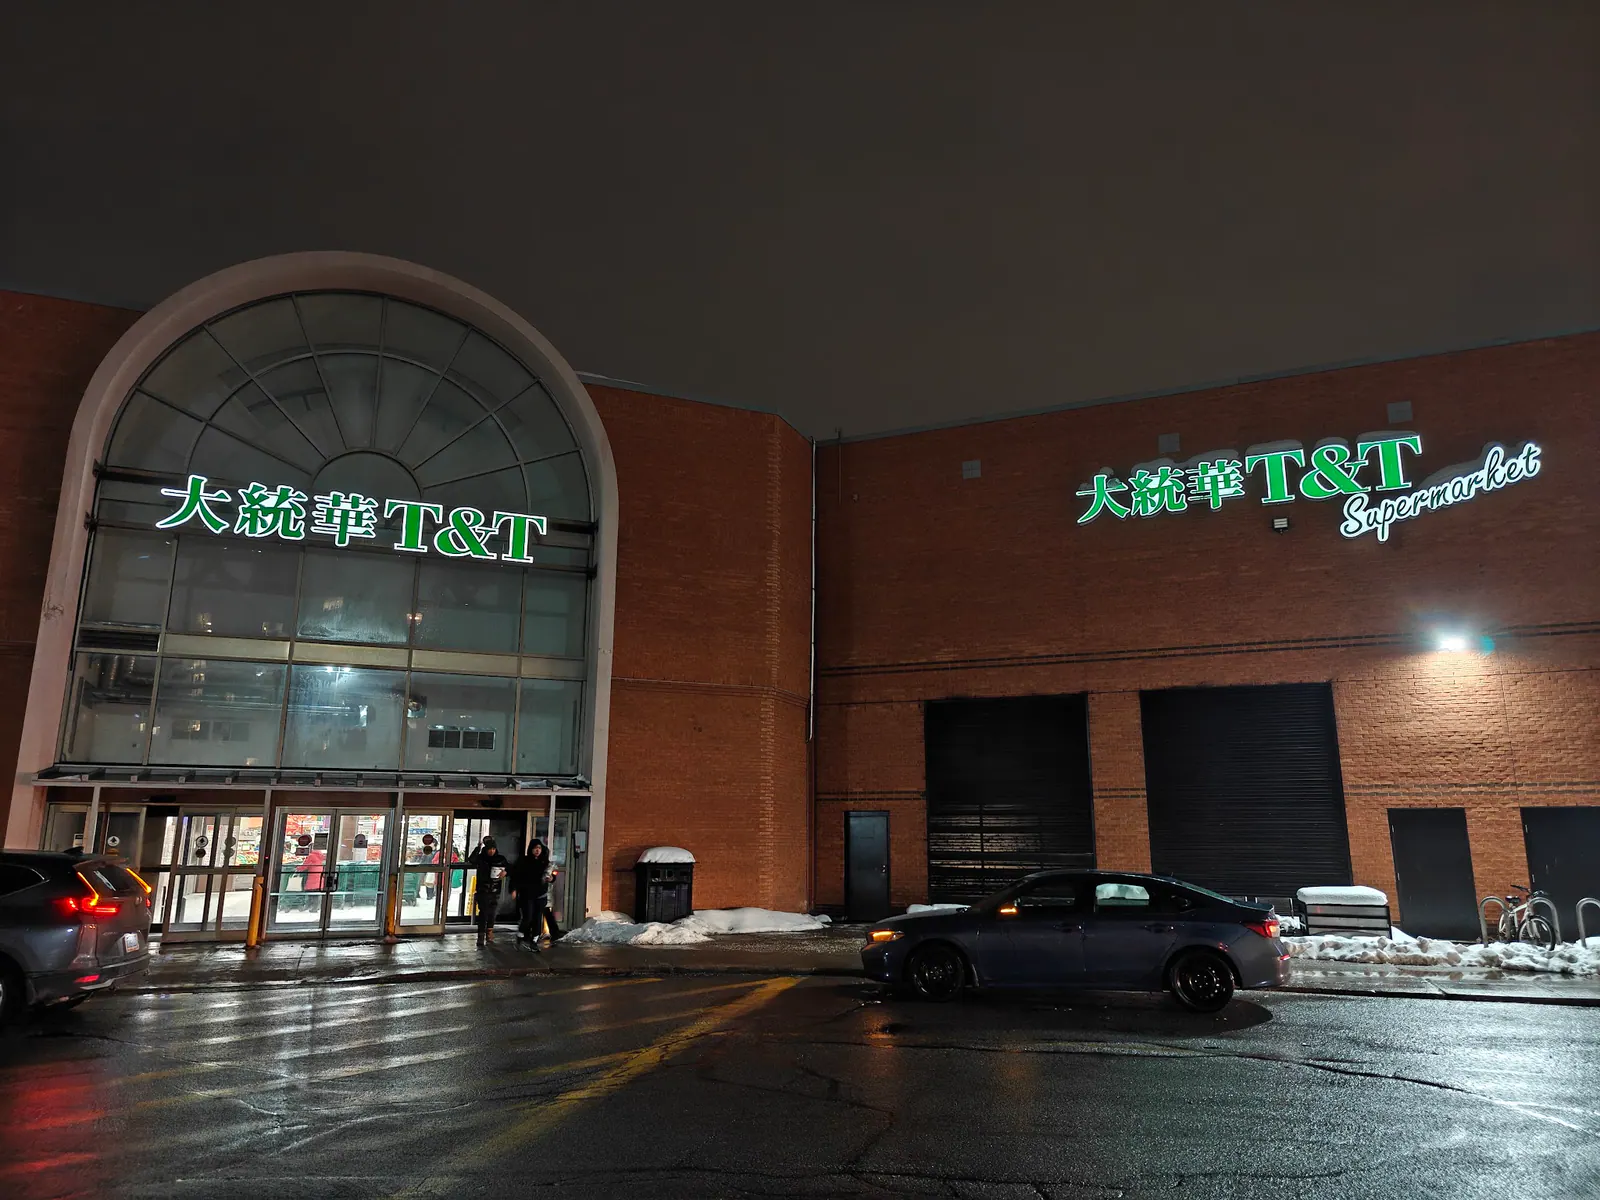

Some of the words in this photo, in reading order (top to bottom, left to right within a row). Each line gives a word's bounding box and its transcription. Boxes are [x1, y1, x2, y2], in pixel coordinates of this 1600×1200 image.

[156, 475, 379, 546] 大統華
[383, 498, 547, 563] T&T
[1076, 460, 1245, 524] 大統華
[1245, 434, 1423, 505] T&T
[1340, 443, 1542, 541] Supermarket
